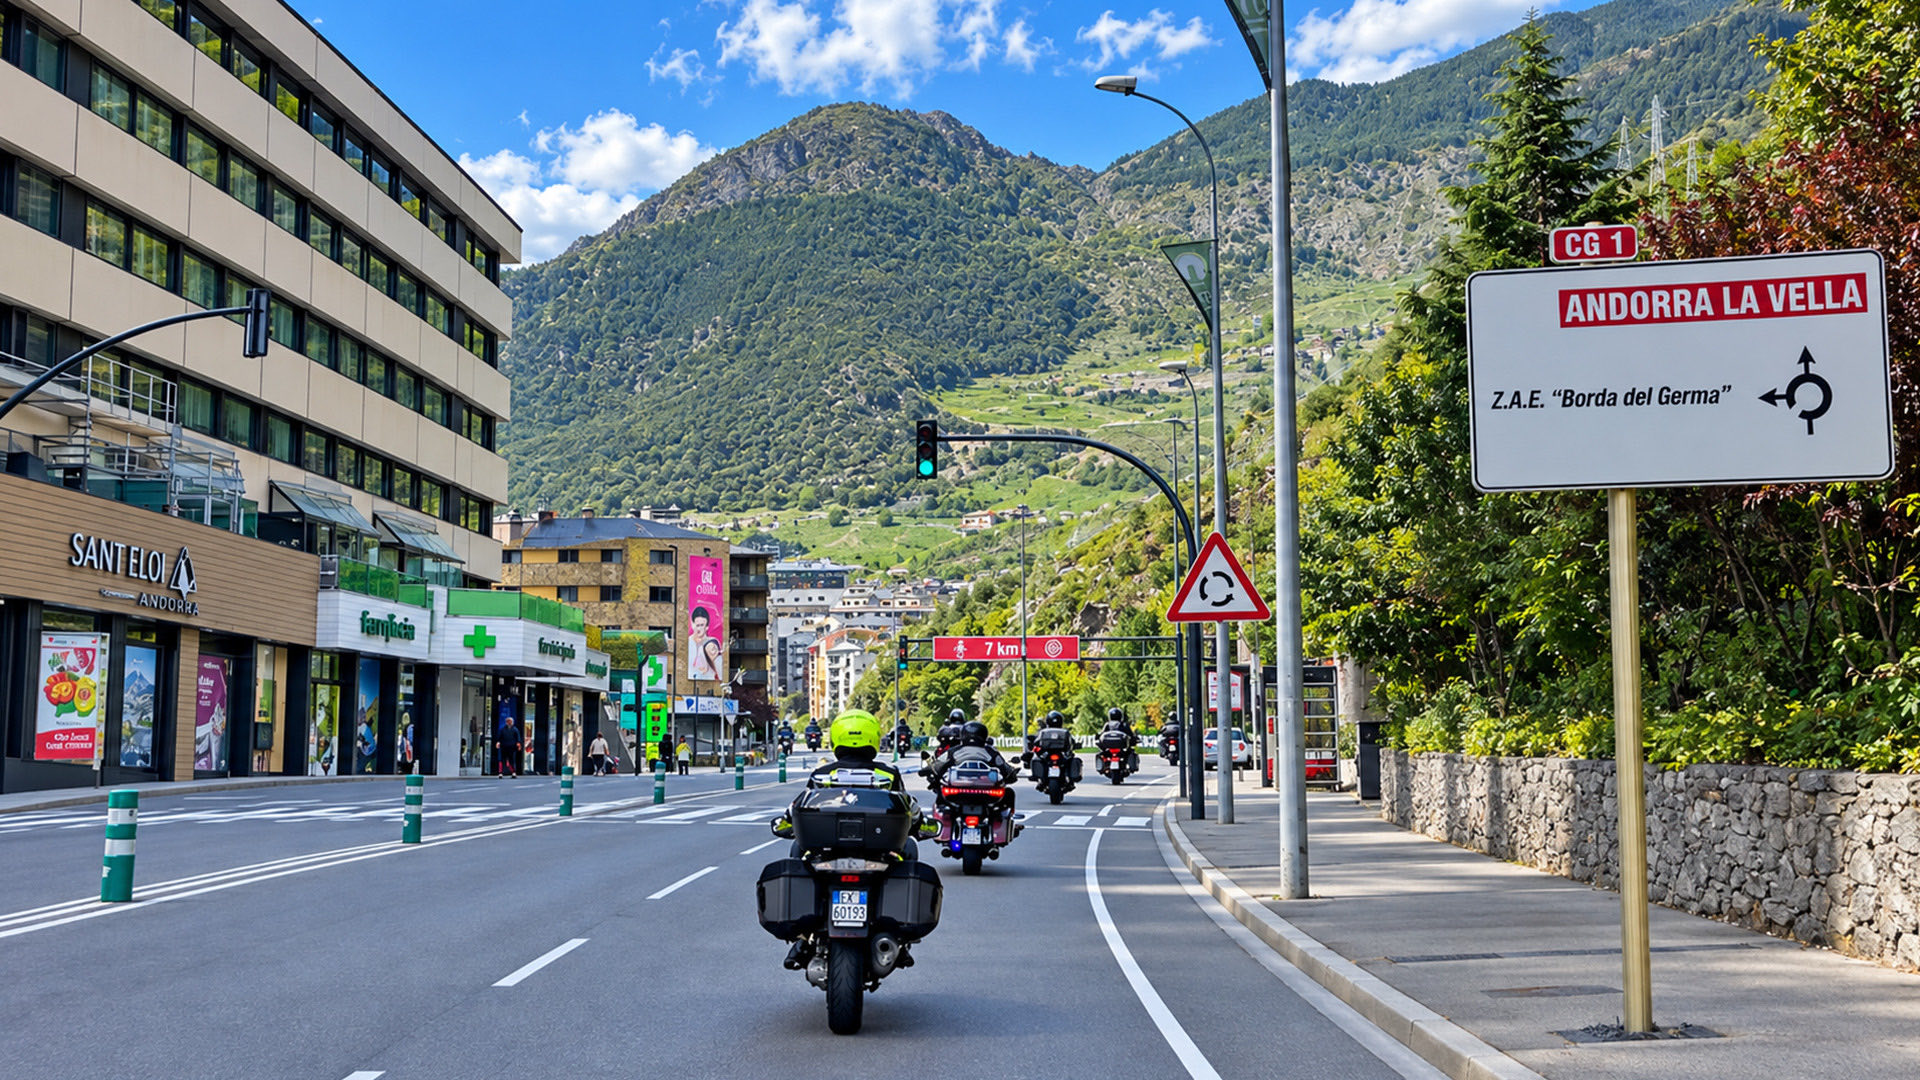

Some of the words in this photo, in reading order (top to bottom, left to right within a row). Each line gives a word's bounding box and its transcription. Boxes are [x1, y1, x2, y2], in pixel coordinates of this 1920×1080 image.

[1565, 231, 1600, 257] CG
[1610, 230, 1623, 255] 1
[1565, 286, 1714, 323] ANDORRA
[1723, 285, 1760, 315] LA
[1767, 278, 1863, 312] VELLA
[1491, 390, 1545, 409] Z.A.E.
[1623, 387, 1654, 406] del
[70, 532, 126, 575] SANT
[128, 546, 166, 584] ELOI
[138, 592, 200, 616] ANDORRA
[984, 641, 993, 656] 7
[997, 641, 1019, 656] km
[833, 906, 866, 919] 60193
